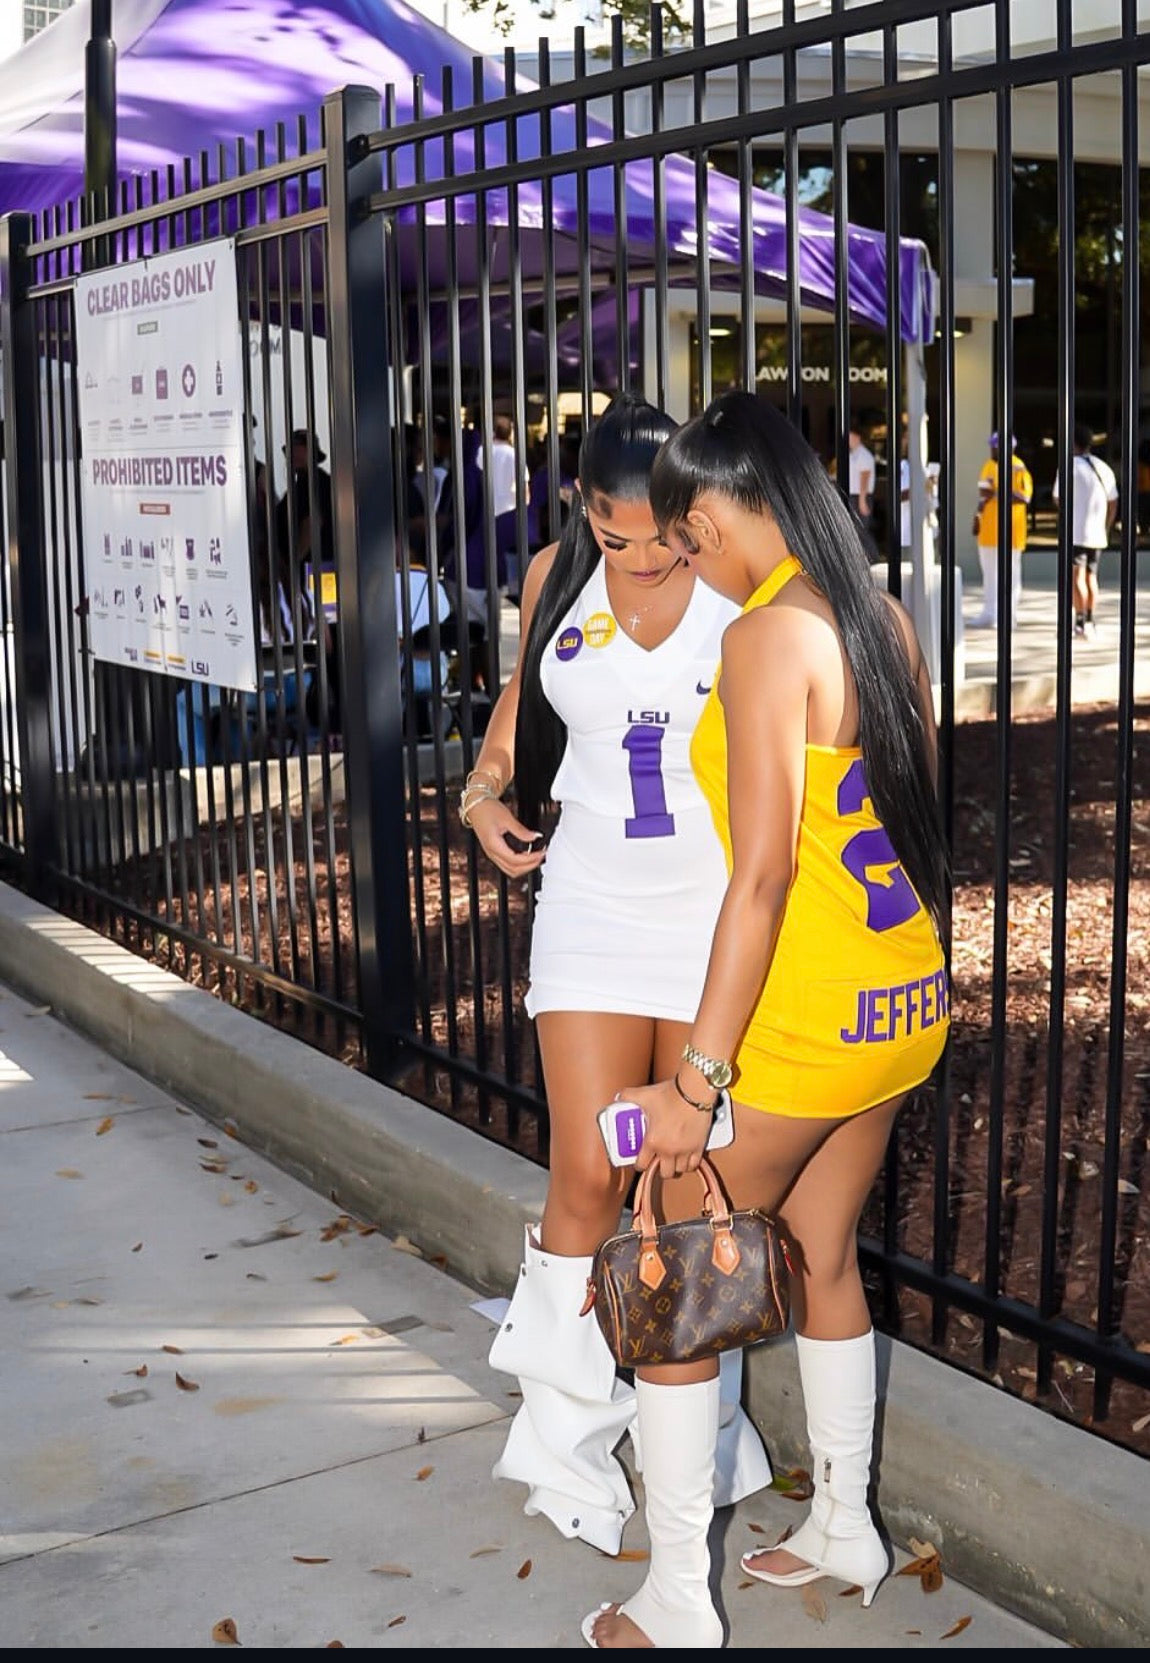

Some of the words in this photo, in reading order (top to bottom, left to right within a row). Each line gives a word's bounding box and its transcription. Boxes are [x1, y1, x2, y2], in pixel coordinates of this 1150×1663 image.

[87, 281, 129, 316] CLEAR
[131, 271, 171, 306] BAGS
[174, 259, 216, 298] ONLY
[755, 365, 830, 382] AWON
[92, 456, 173, 486] PROHIBITED
[175, 454, 228, 487] ITEMS
[557, 638, 578, 650] LSU
[191, 660, 209, 676] LSU
[627, 709, 670, 724] LSU
[621, 724, 676, 839] 1
[836, 757, 922, 934] 2
